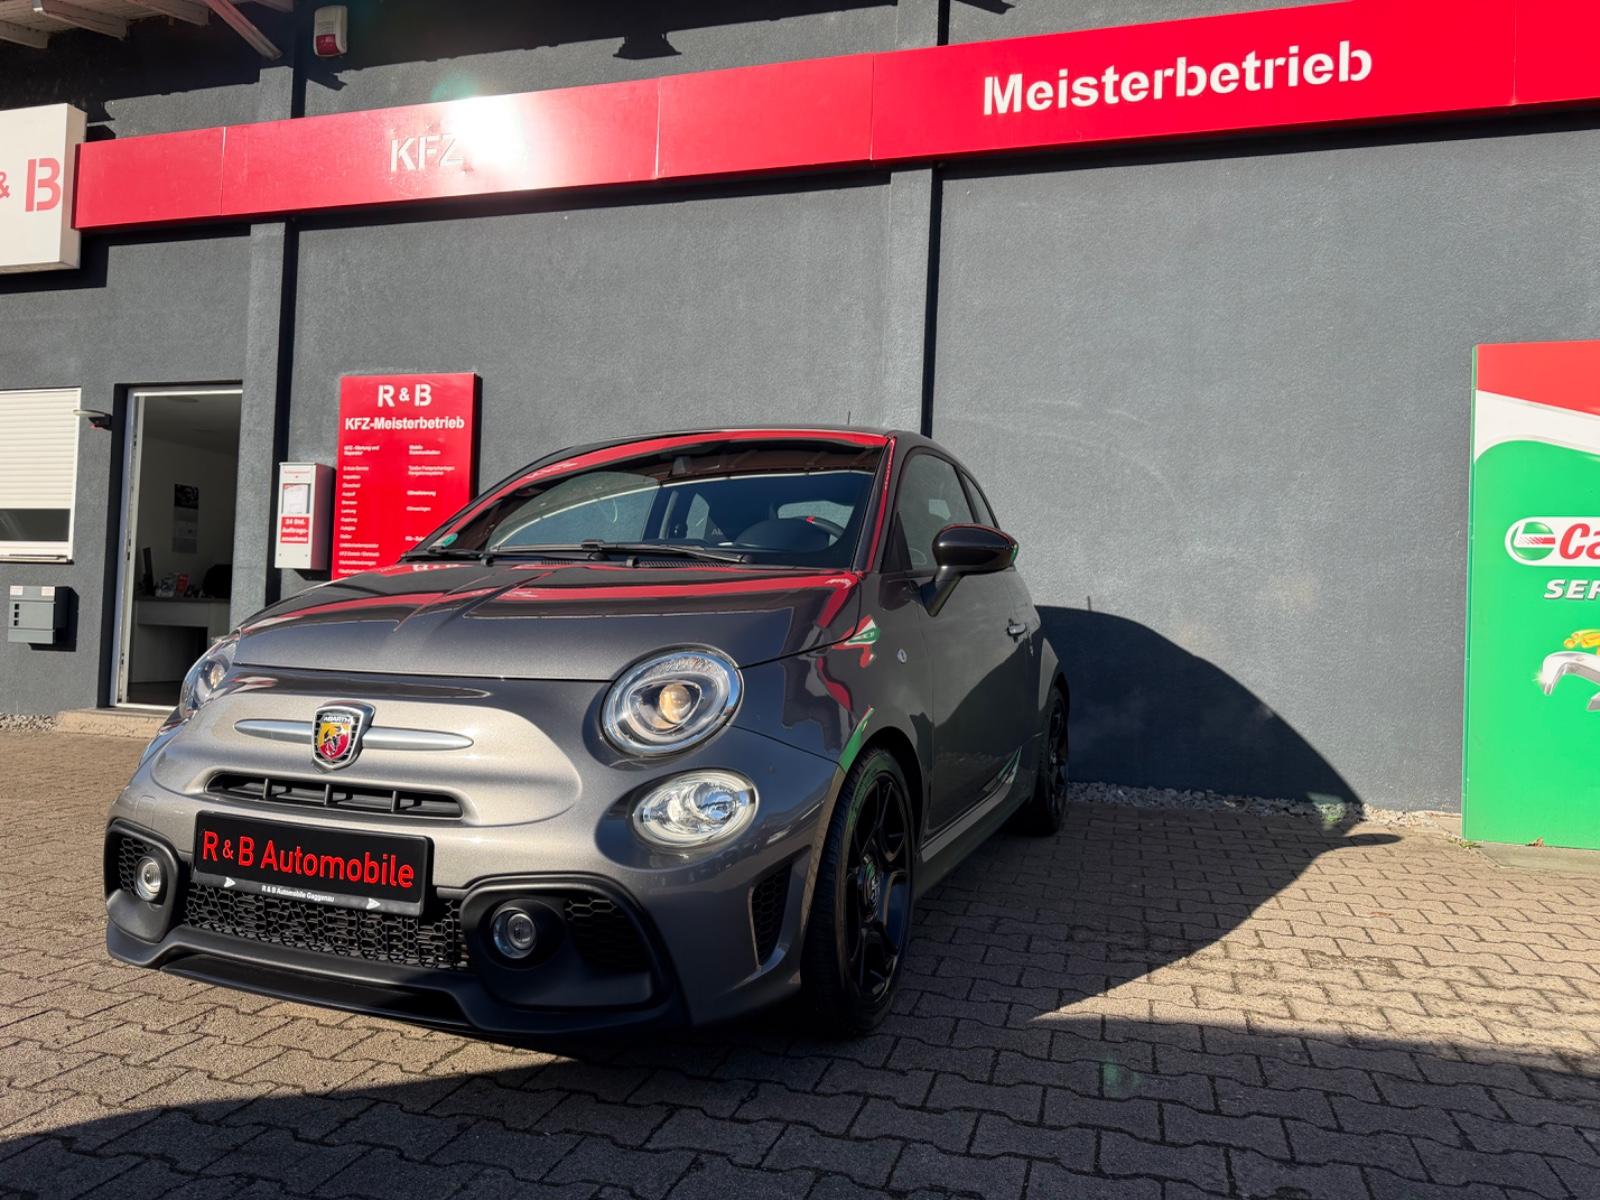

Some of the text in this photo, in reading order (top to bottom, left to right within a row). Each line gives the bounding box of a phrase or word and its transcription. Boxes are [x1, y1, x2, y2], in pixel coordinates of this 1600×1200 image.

[983, 40, 1372, 116] Meisterbetrieb
[390, 133, 464, 173] KFZ
[25, 157, 61, 212] B
[377, 383, 432, 408] R & B
[345, 416, 465, 431] KFZ-Meisterbetrieb
[203, 830, 415, 888] R & B Automobile
[276, 887, 306, 898] Automobile
[307, 892, 335, 902] Gaggenau
